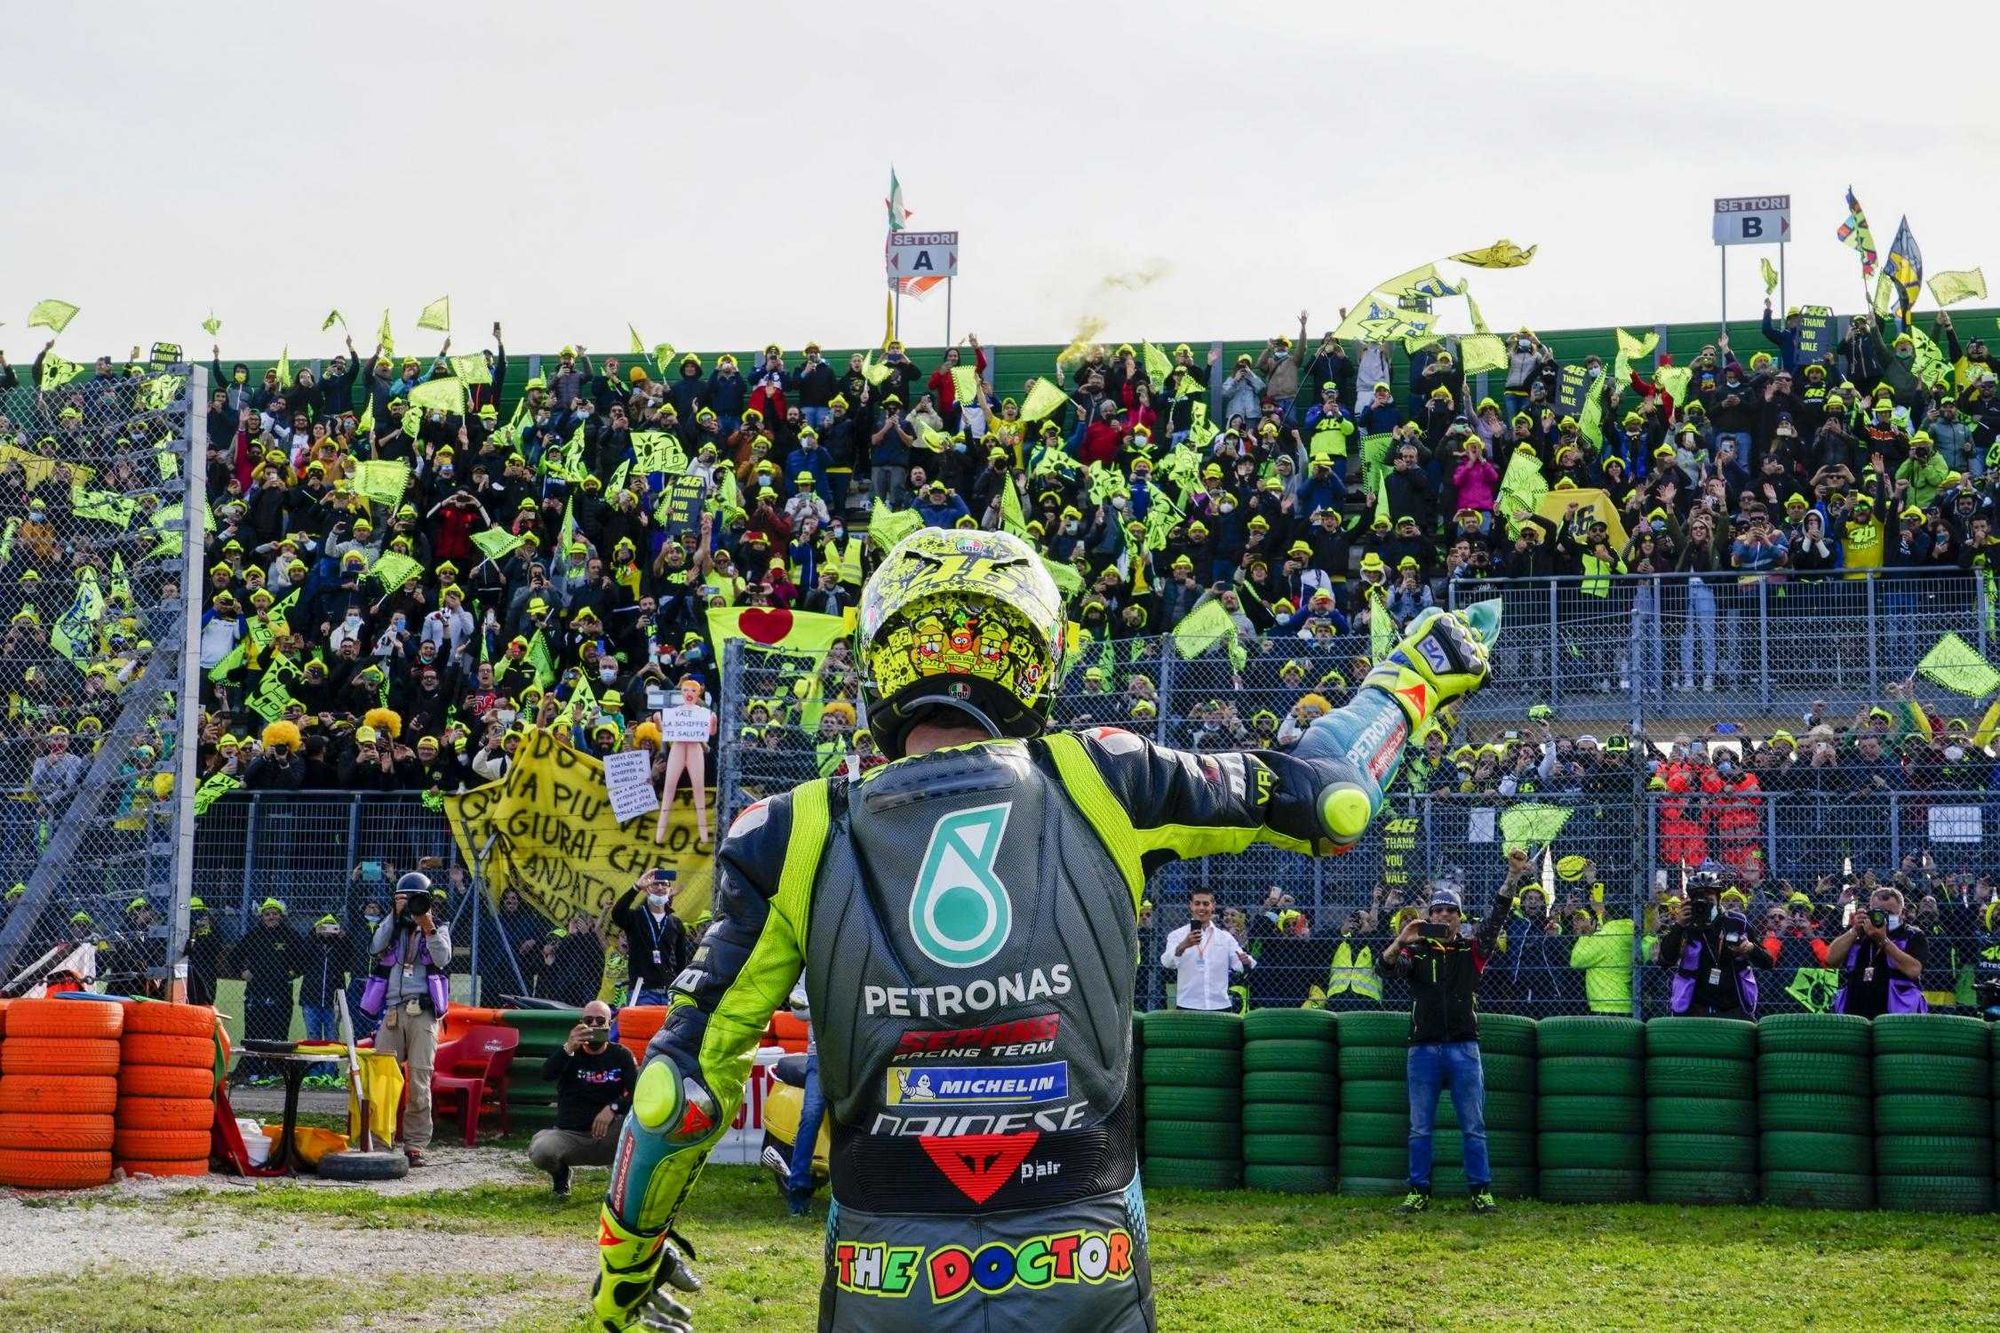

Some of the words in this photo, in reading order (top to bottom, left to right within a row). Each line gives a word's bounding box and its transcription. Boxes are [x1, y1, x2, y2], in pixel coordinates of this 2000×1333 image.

[1718, 197, 1787, 212] SETTORI
[1742, 217, 1763, 238] B
[894, 234, 956, 245] SETTORI
[913, 250, 934, 270] A
[1802, 330, 1816, 340] YOU
[1801, 342, 1818, 352] VALE
[1563, 374, 1584, 387] THANK
[1562, 385, 1575, 396] YOU
[1805, 388, 1826, 398] 46
[1561, 395, 1577, 406] VALE
[1315, 417, 1341, 431] 46
[672, 511, 689, 522] VALE
[1384, 818, 1419, 834] 46
[507, 809, 597, 861] GIURAI
[1384, 837, 1415, 849] THANK
[1385, 854, 1403, 867] YOU
[1385, 871, 1408, 884] VALE
[864, 963, 1072, 1017] PETRONAS
[898, 1015, 1061, 1050] SEPANG
[892, 1048, 981, 1062] RACING
[985, 1040, 1055, 1057] TEAM
[939, 1075, 1055, 1094] MICHELIN
[836, 1240, 925, 1298] THE
[926, 1228, 1134, 1304] DOCTOR
